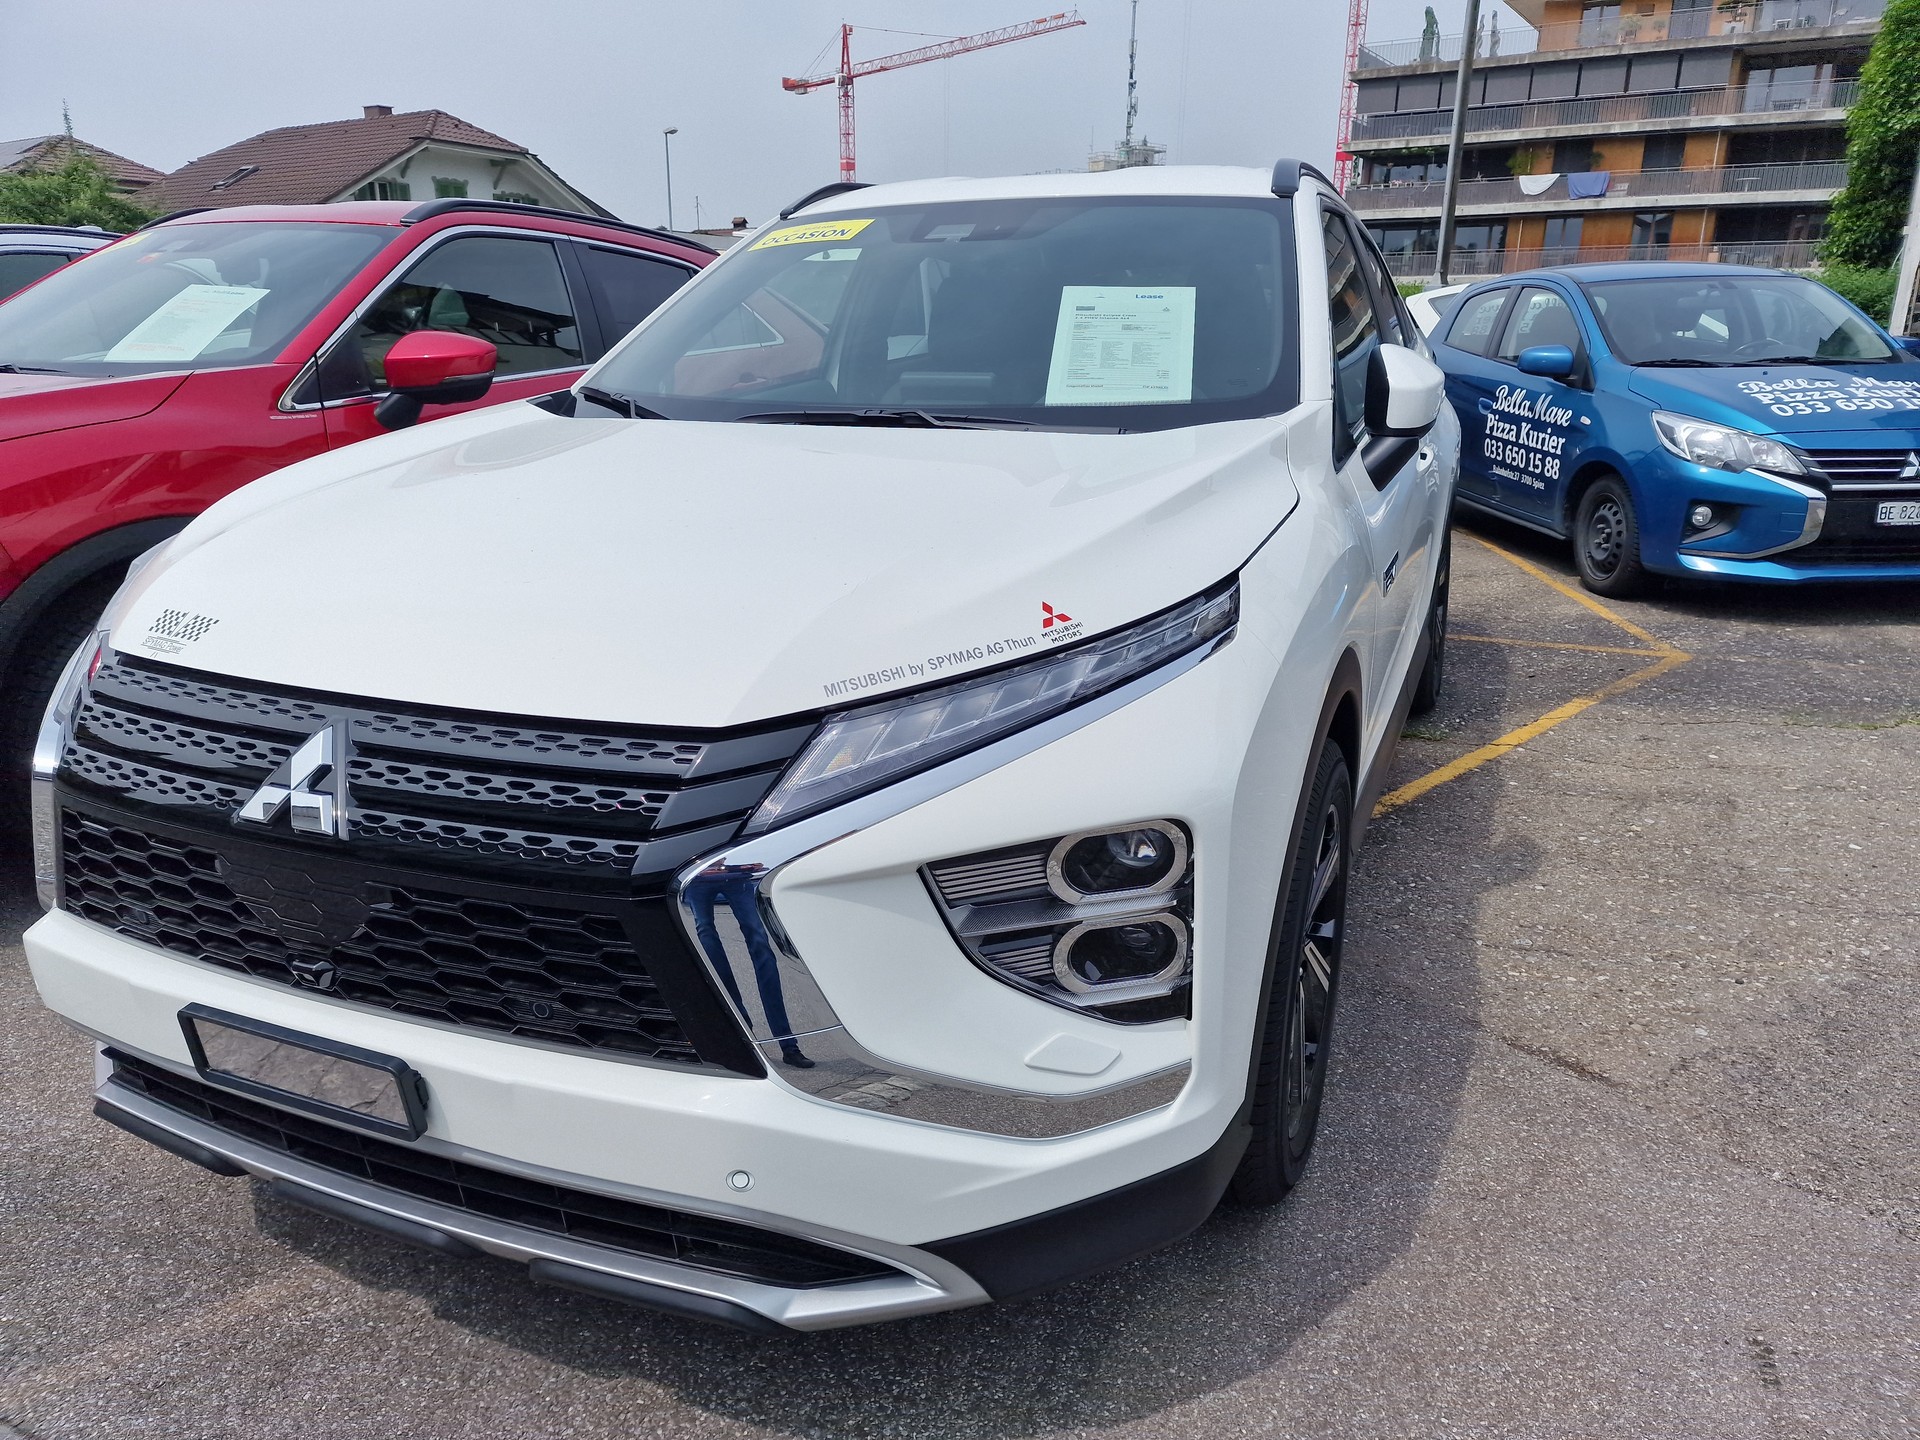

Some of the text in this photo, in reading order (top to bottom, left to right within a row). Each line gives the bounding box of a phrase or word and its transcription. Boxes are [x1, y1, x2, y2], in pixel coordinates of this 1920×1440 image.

[762, 228, 852, 246] OCCASION
[1738, 378, 1840, 394] Bella
[1493, 384, 1573, 427] Bella Mare
[1750, 389, 1850, 404] Pizza
[1770, 400, 1832, 417] 033
[1836, 397, 1895, 411] 650
[1485, 413, 1566, 455] Pizza Kurier
[1484, 437, 1560, 480] 033 650 15 88
[1520, 474, 1533, 486] 3700
[1880, 505, 1896, 520] BE
[1041, 621, 1083, 639] MITSUBISHI
[1051, 630, 1082, 644] MOTORS
[823, 635, 1037, 698] MITSUBISHI by SPYMAG AG Thun
